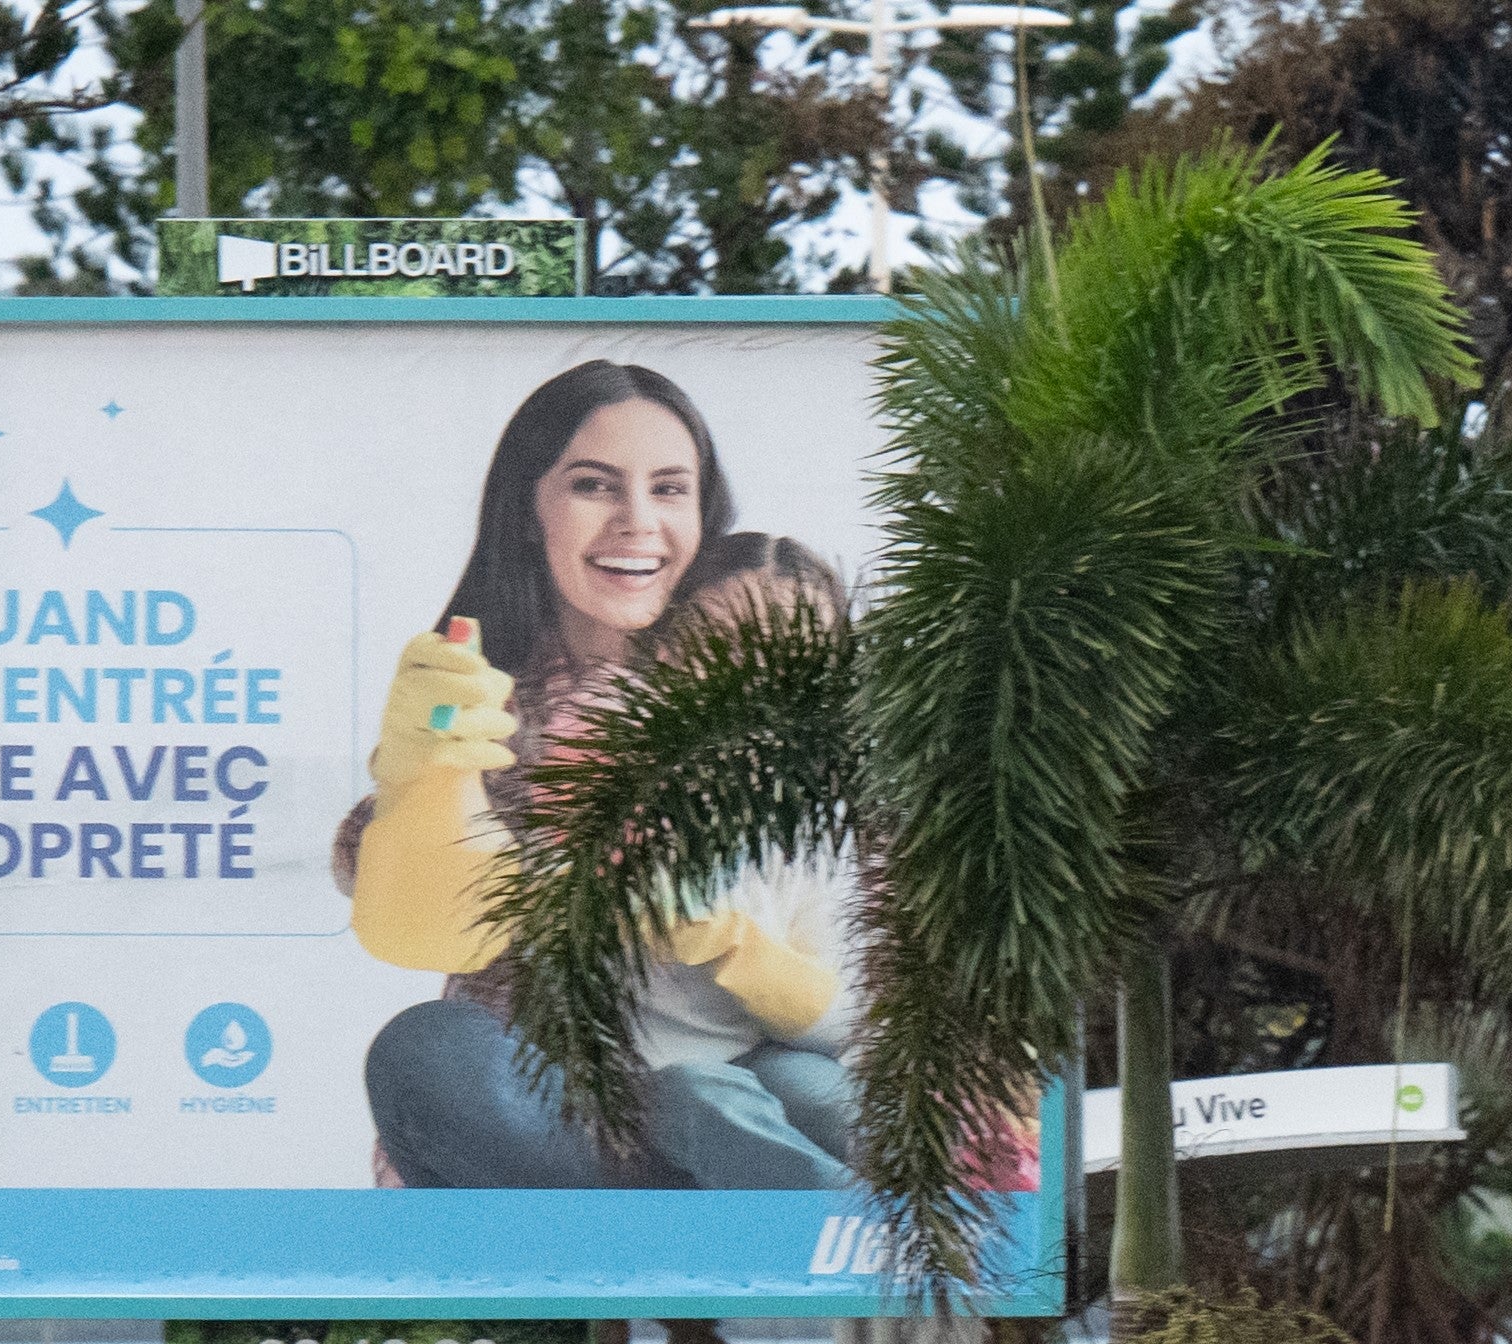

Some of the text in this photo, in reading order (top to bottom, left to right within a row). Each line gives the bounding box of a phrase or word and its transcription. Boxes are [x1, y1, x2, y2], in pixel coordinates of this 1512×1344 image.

[55, 744, 270, 802] AVEC
[13, 1096, 133, 1114] ENTRETIEN
[1195, 1093, 1266, 1124] Vive
